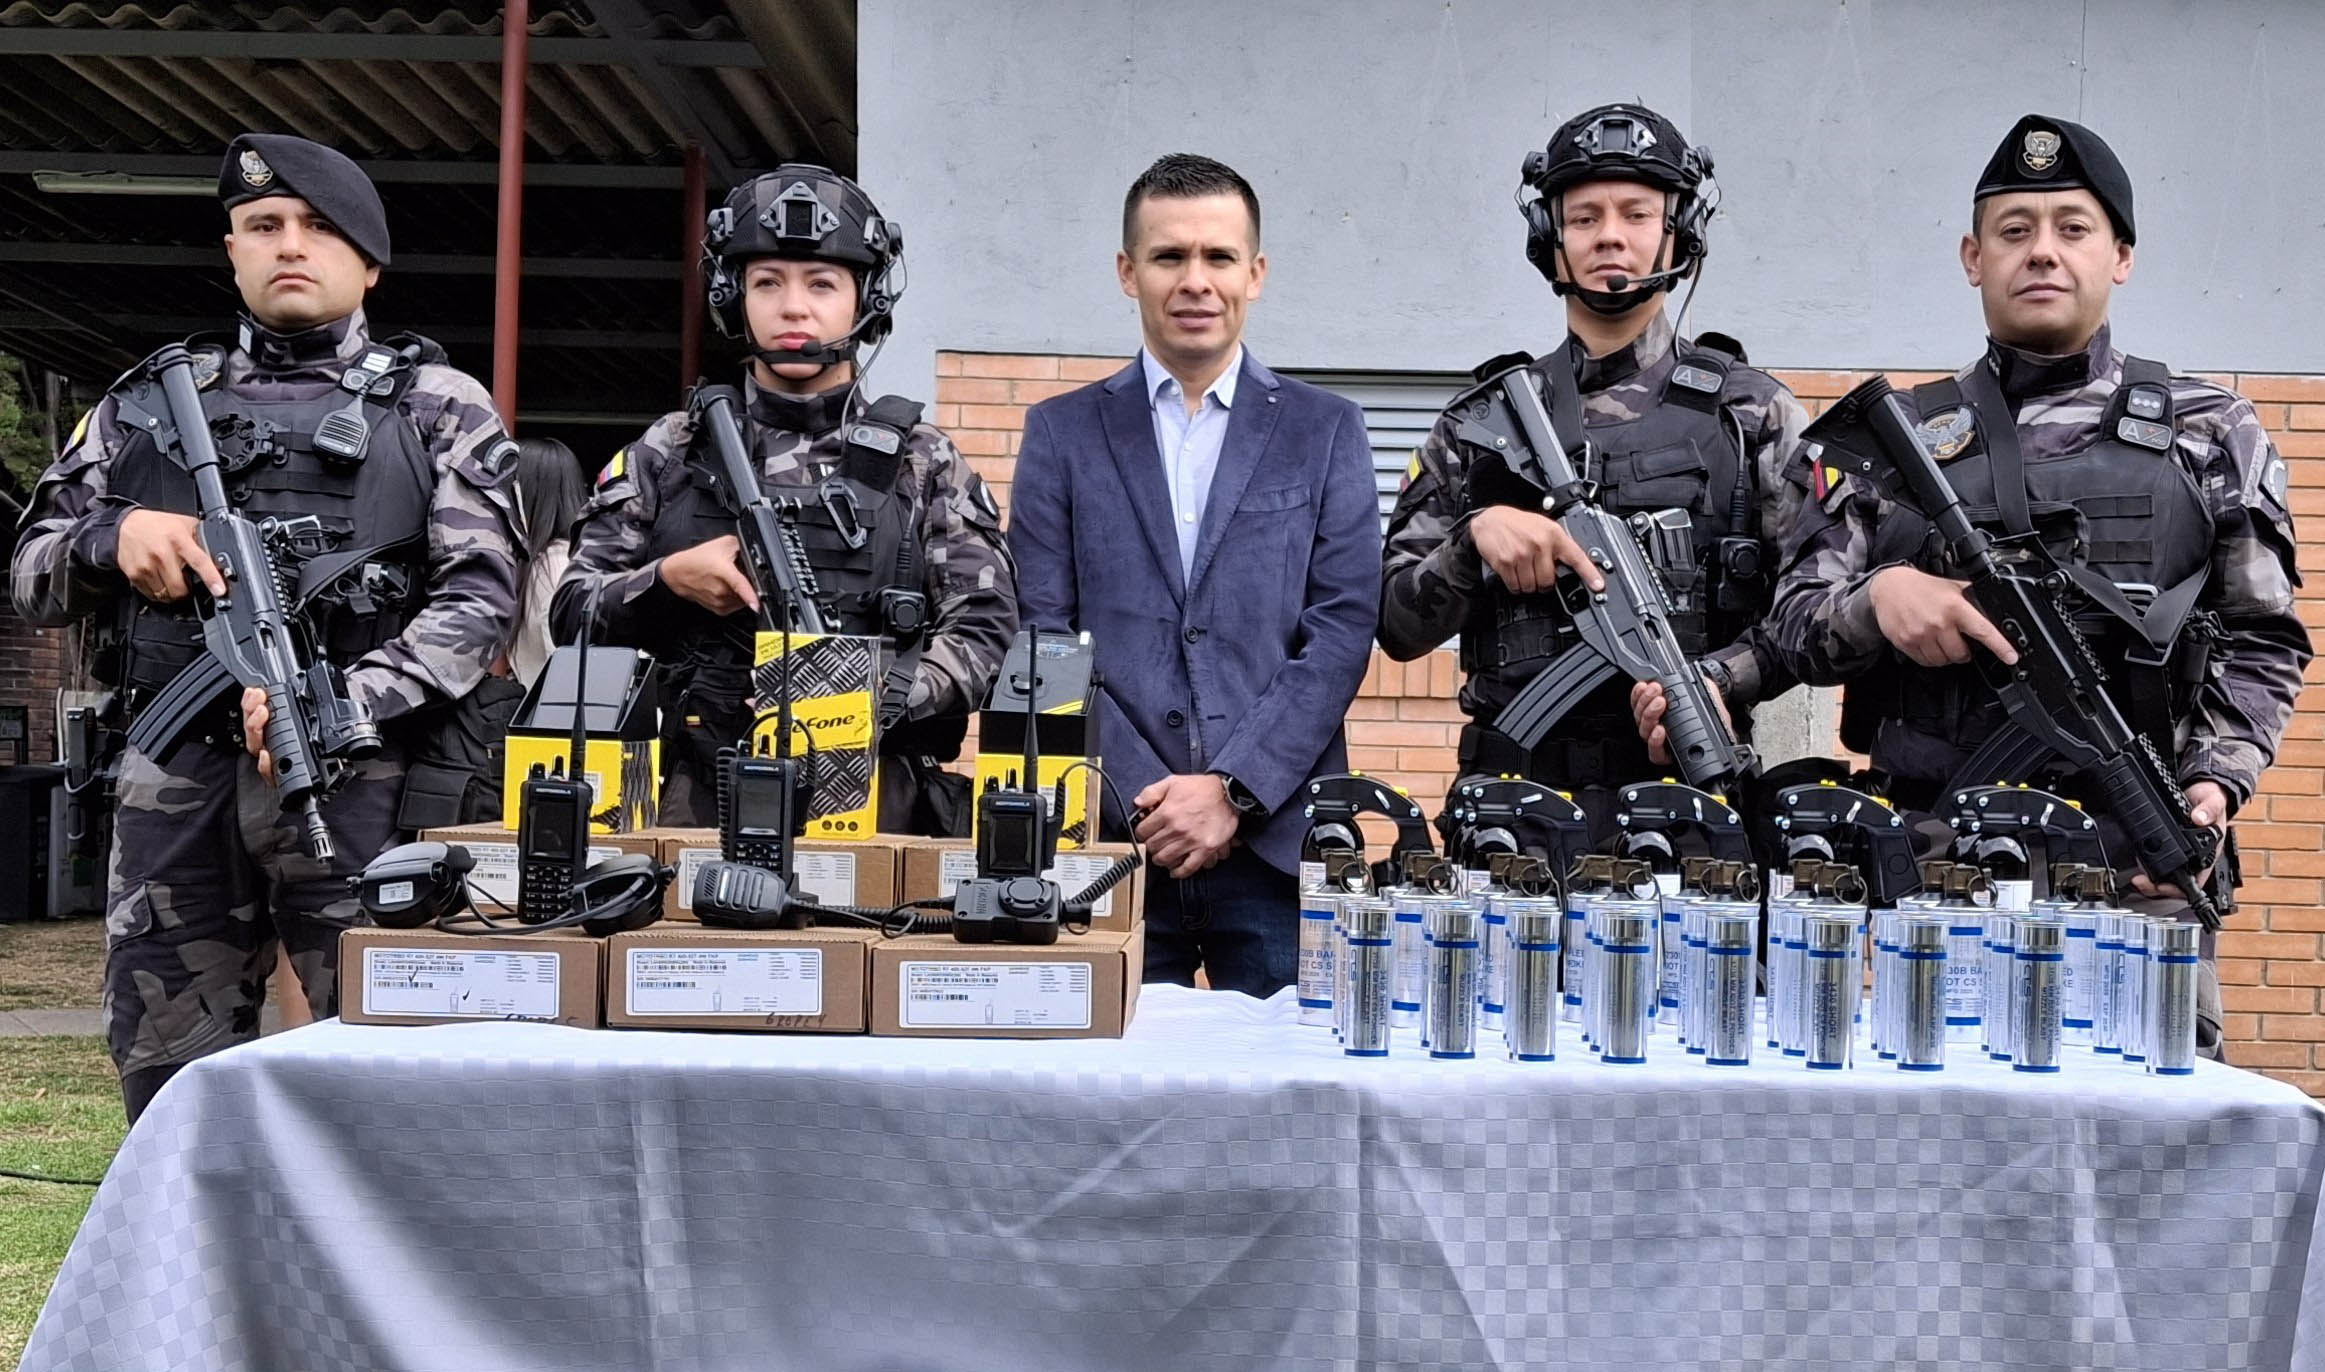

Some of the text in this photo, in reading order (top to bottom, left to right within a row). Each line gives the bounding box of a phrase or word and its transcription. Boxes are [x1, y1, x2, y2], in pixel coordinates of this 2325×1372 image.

[1675, 368, 1692, 385] A
[2123, 421, 2141, 441] A
[1963, 977, 1977, 986] CS
[1829, 1005, 1837, 1040] SHORT
